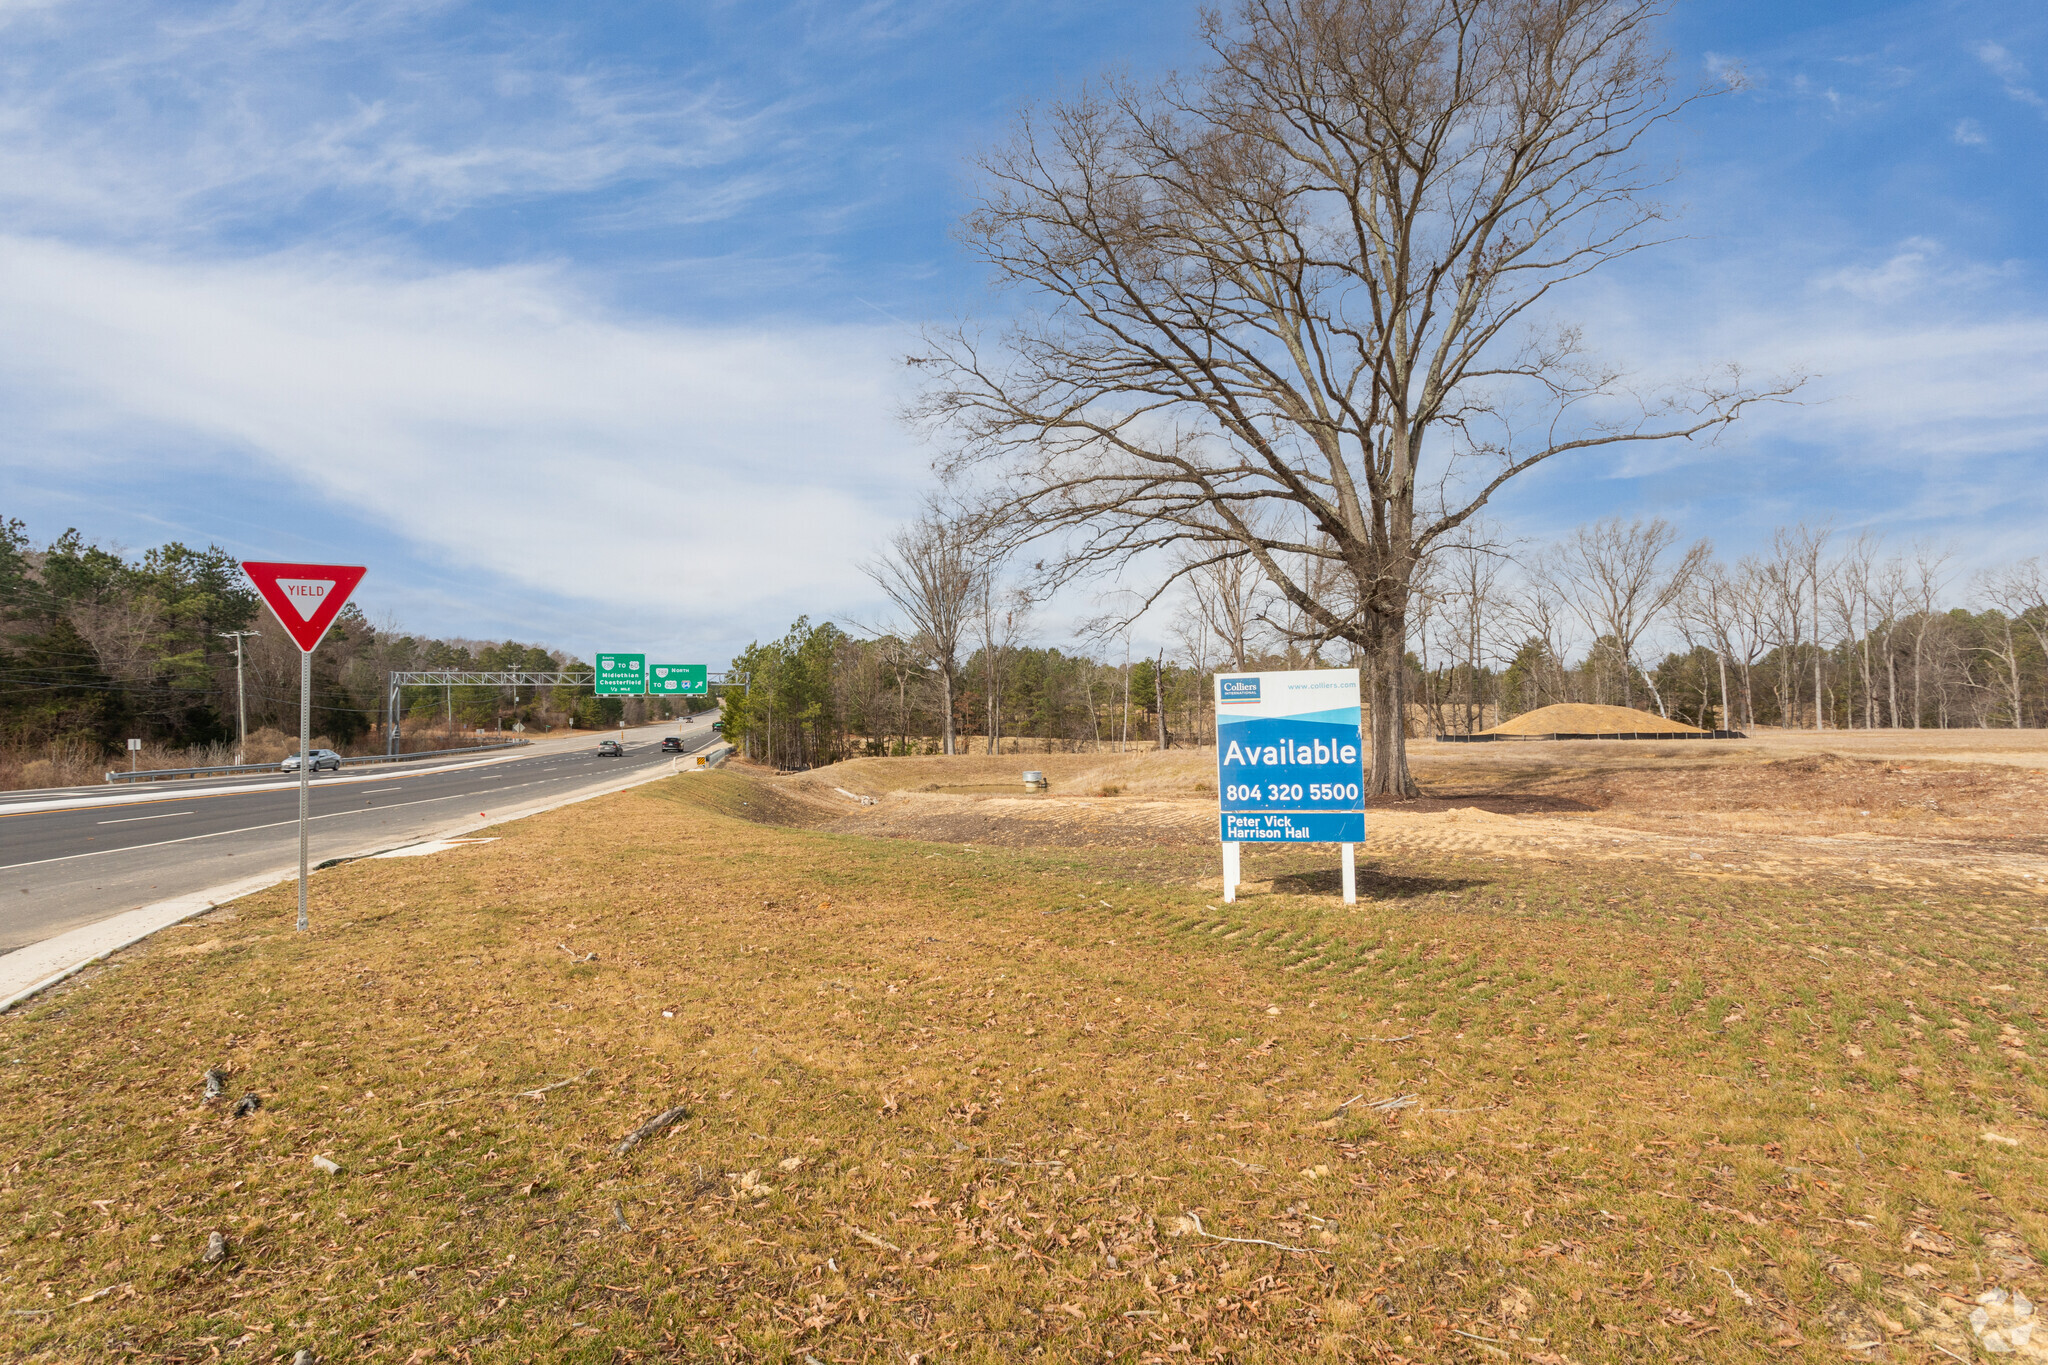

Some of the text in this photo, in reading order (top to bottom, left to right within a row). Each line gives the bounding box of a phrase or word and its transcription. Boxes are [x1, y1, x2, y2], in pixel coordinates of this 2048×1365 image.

[288, 585, 324, 597] YIELD
[1223, 682, 1257, 691] Colliers
[1288, 682, 1356, 690] www.colliers.com
[1223, 738, 1357, 766] Available
[1226, 783, 1359, 801] 804 320 5500
[1227, 815, 1292, 827] Peter Vick
[1227, 827, 1310, 839] Harrison Hall
